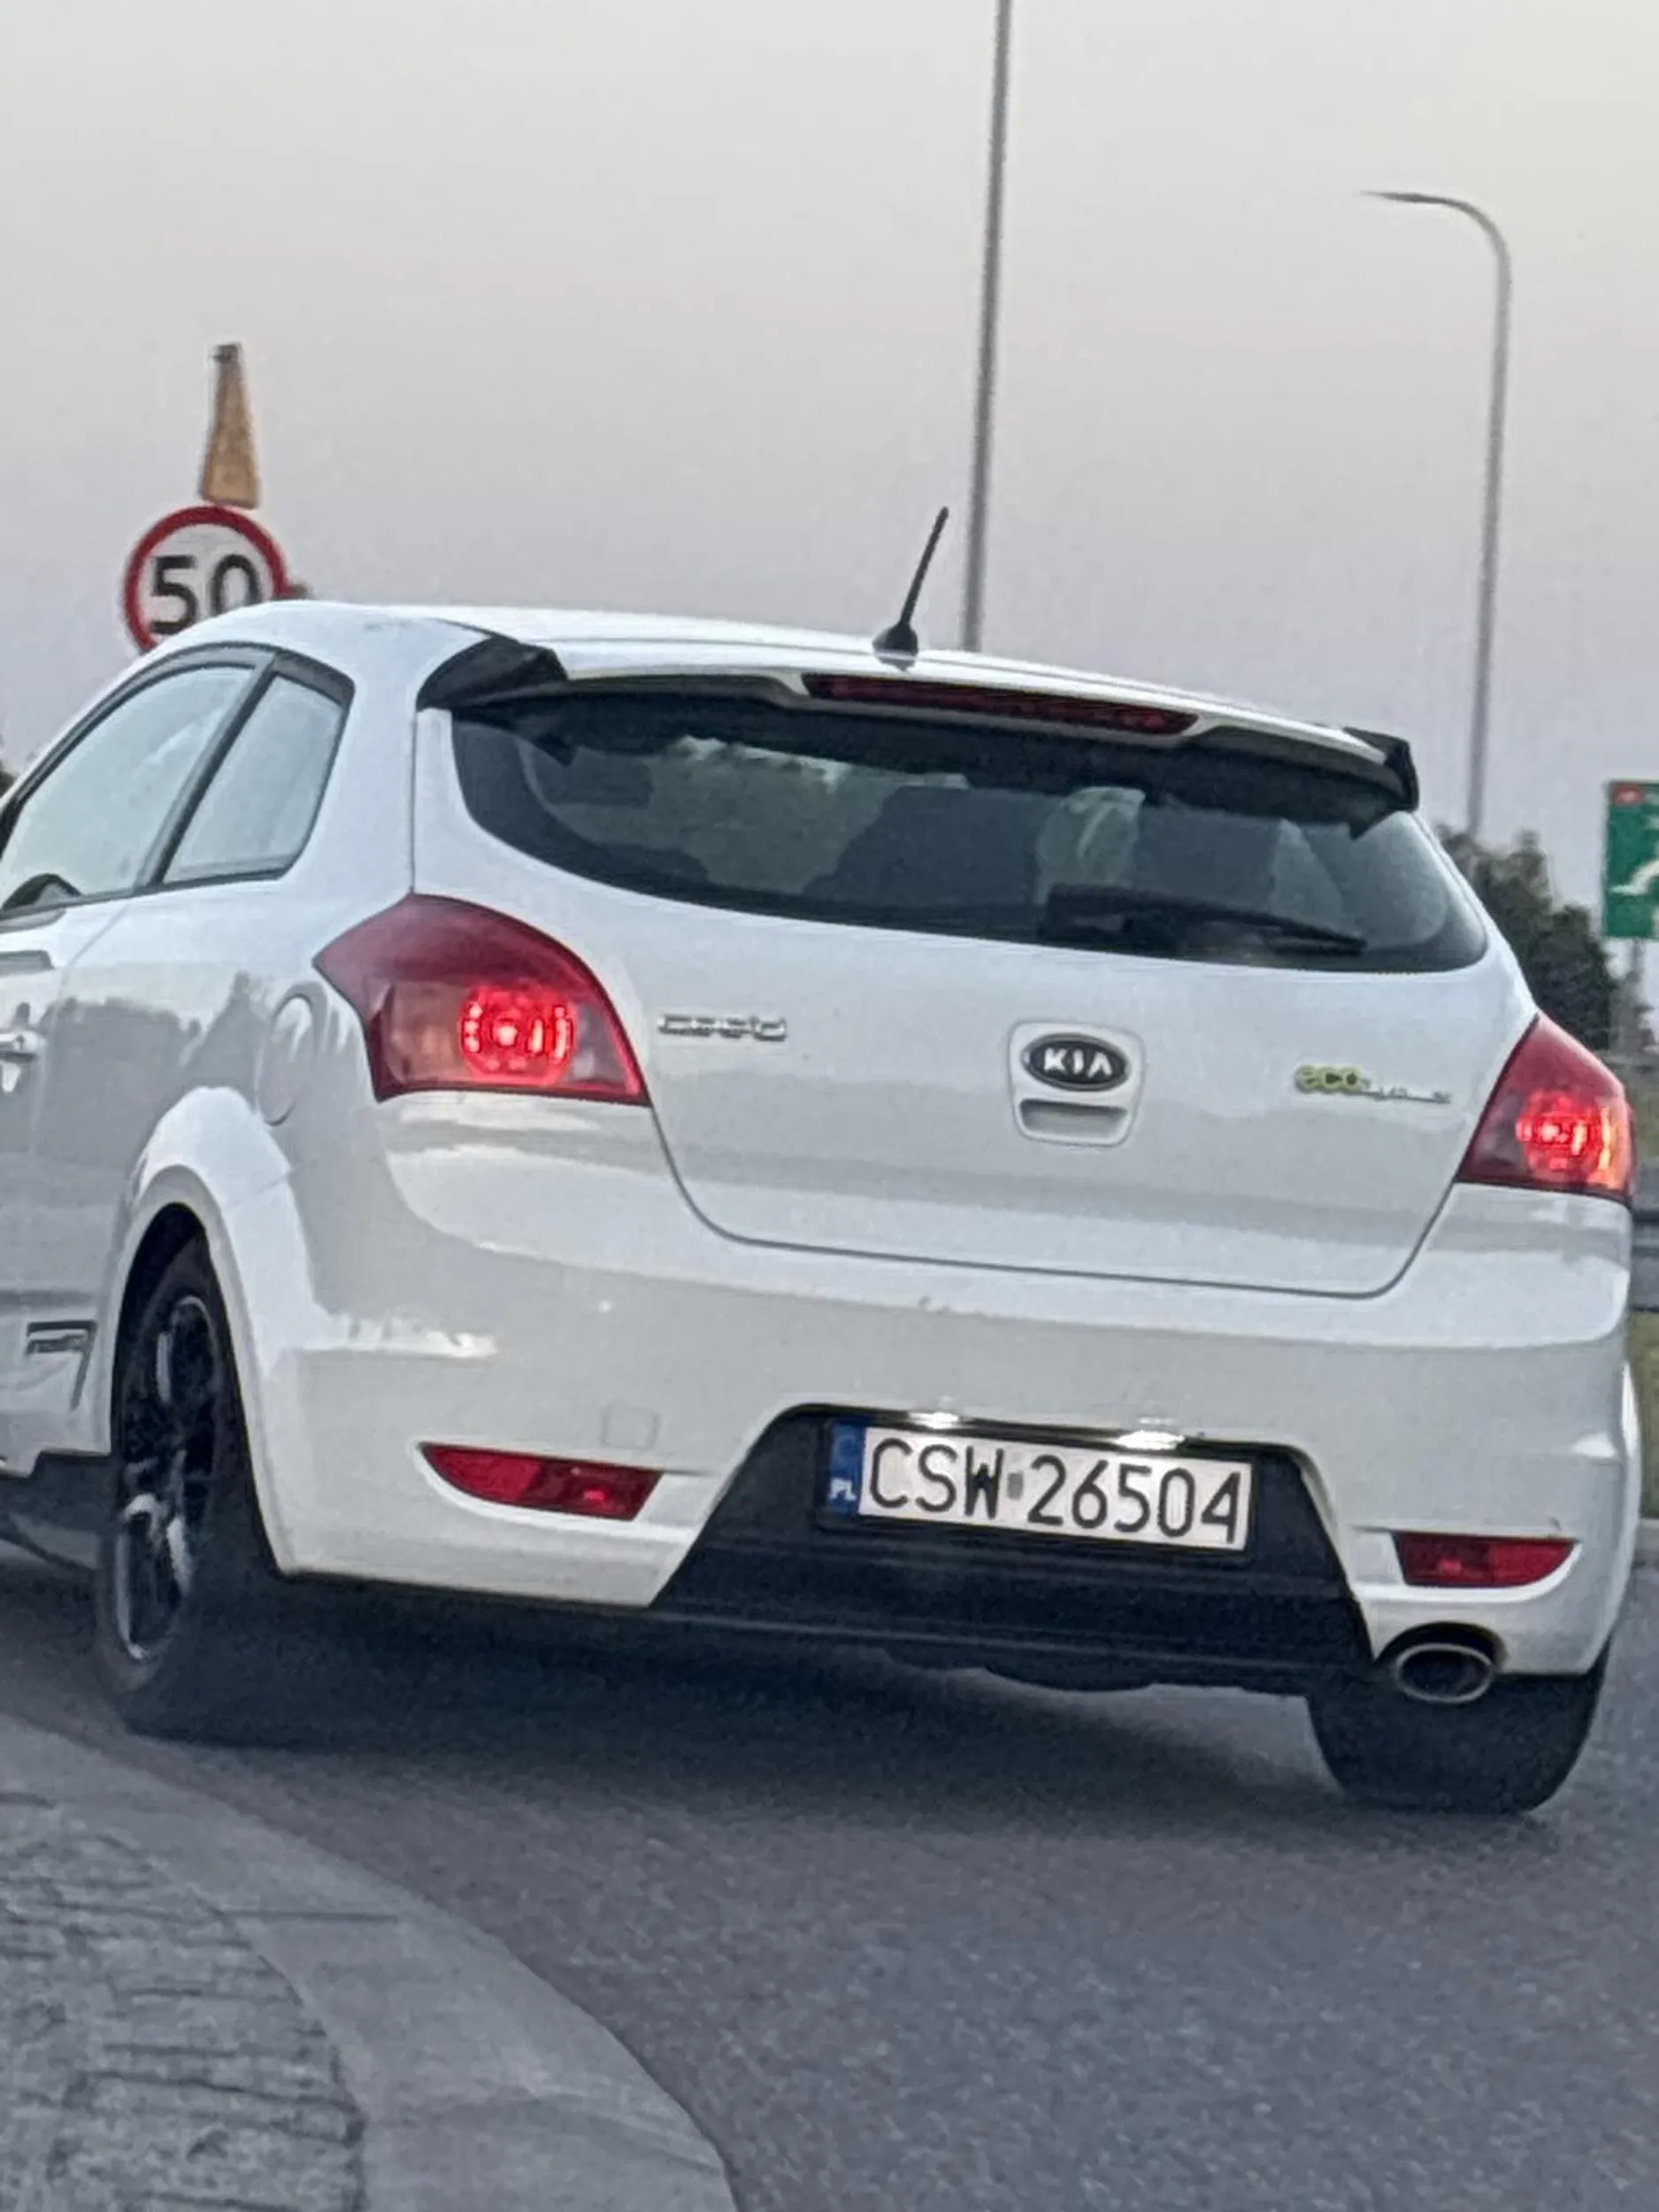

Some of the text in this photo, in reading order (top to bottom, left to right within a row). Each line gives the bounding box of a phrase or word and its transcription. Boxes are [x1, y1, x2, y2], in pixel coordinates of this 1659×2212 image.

[150, 554, 262, 635] 50
[1044, 1048, 1112, 1079] KIA
[829, 1479, 856, 1502] PL
[869, 1438, 1240, 1544] CSW 26504
